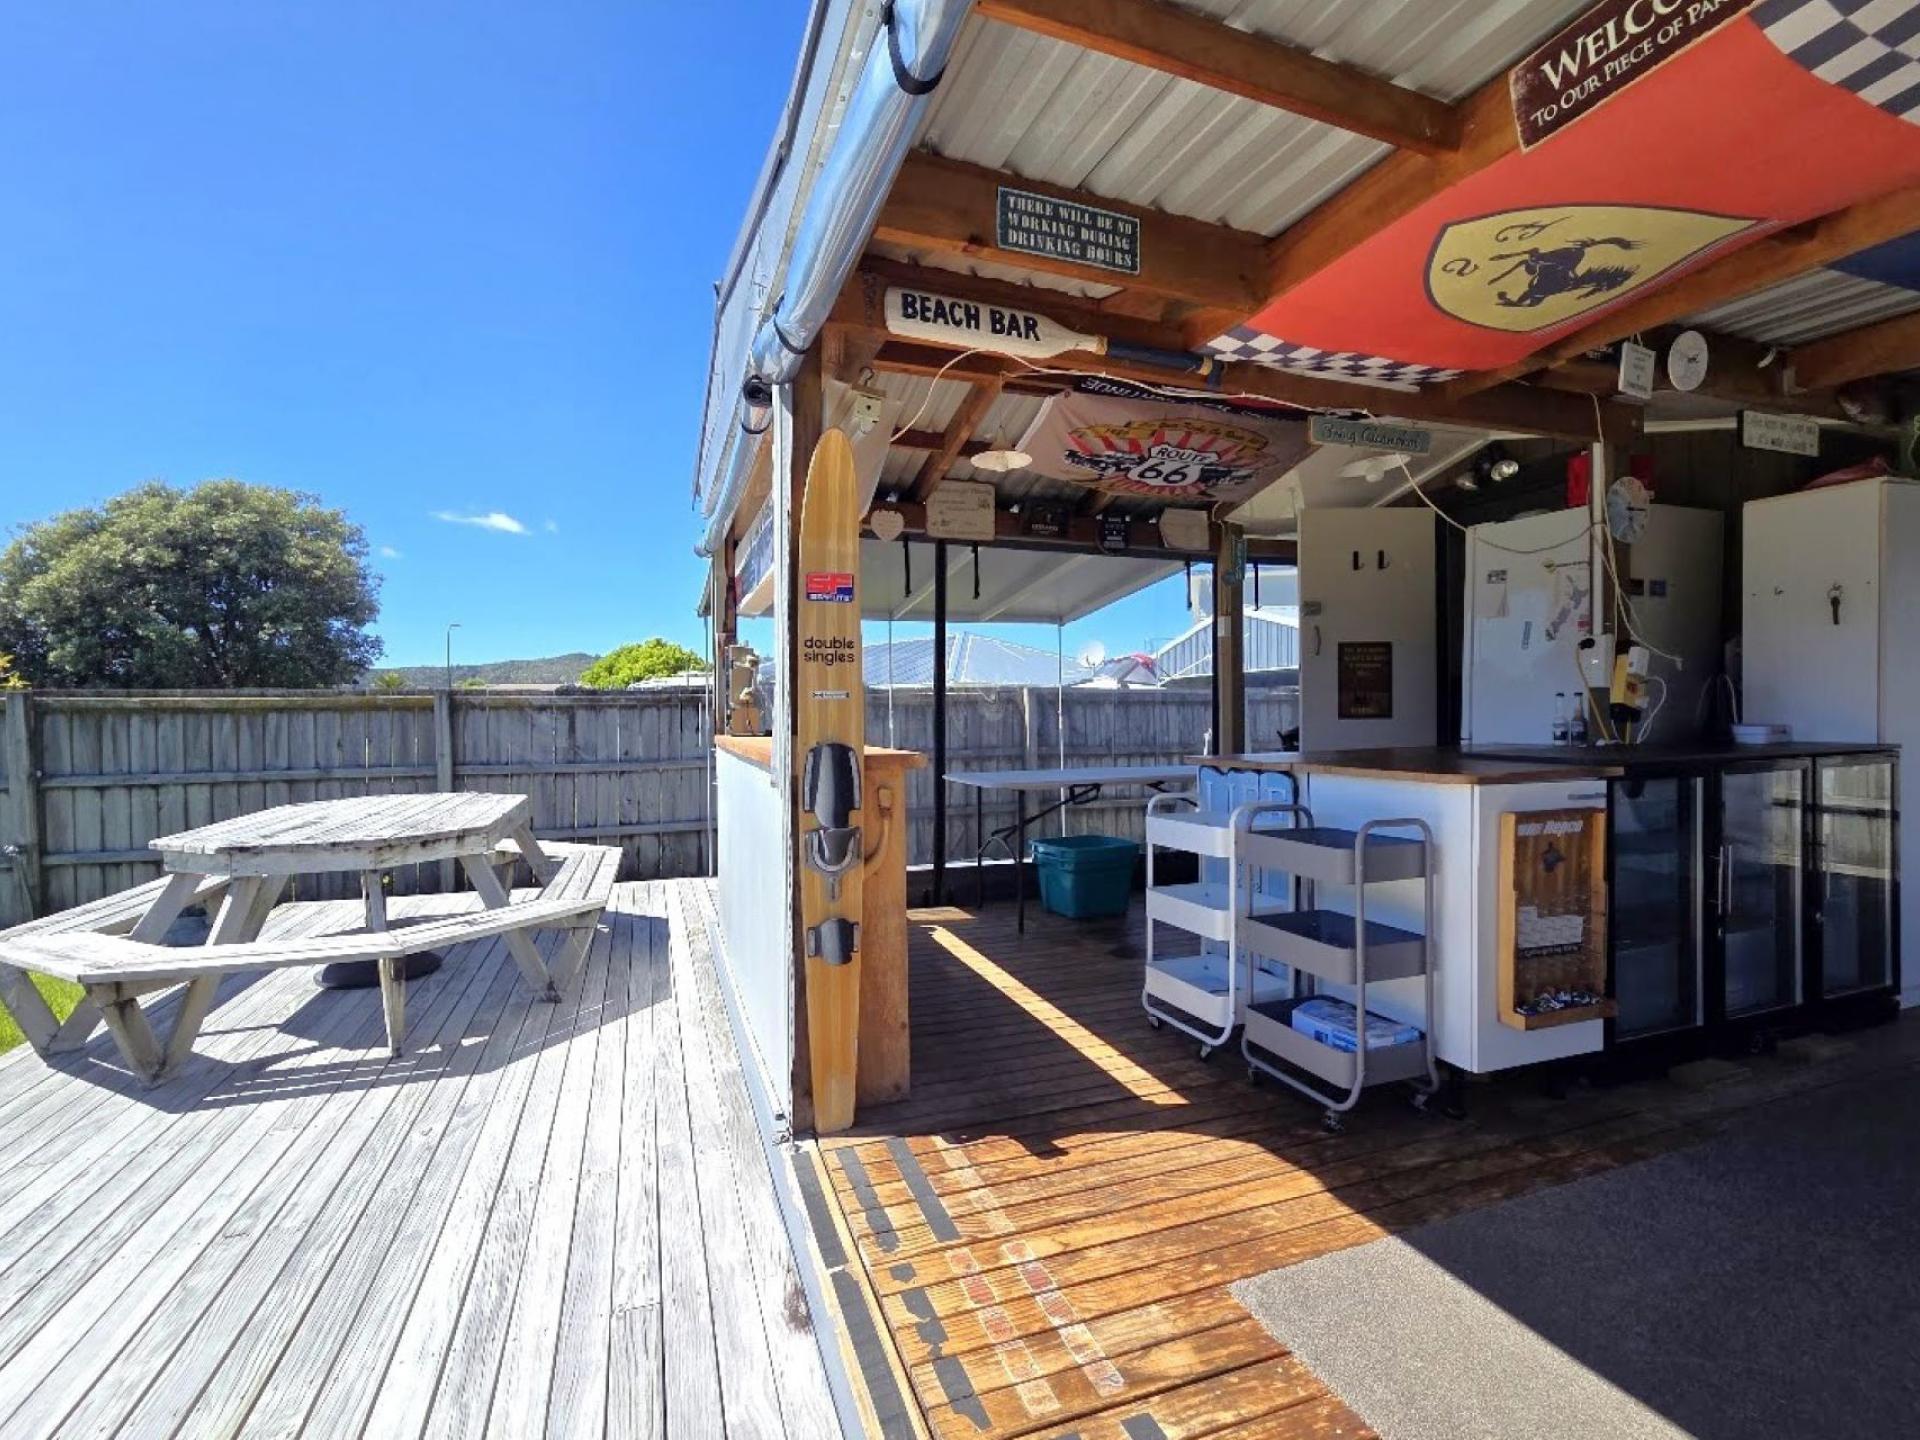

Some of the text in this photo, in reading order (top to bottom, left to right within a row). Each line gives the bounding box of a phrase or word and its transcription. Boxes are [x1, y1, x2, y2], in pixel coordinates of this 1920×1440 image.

[1530, 104, 1557, 127] TO
[1560, 75, 1603, 109] OUR
[1604, 38, 1656, 81] PIECE
[1657, 17, 1685, 45] OF
[1007, 196, 1132, 235] THERE WILL BE NO
[1007, 212, 1130, 250] WORKING DURING
[1007, 228, 1132, 267] DRINKING HOURS
[901, 293, 1041, 342] BEACH BAR
[1138, 461, 1188, 485] 66
[804, 636, 855, 649] double
[804, 650, 855, 666] singles
